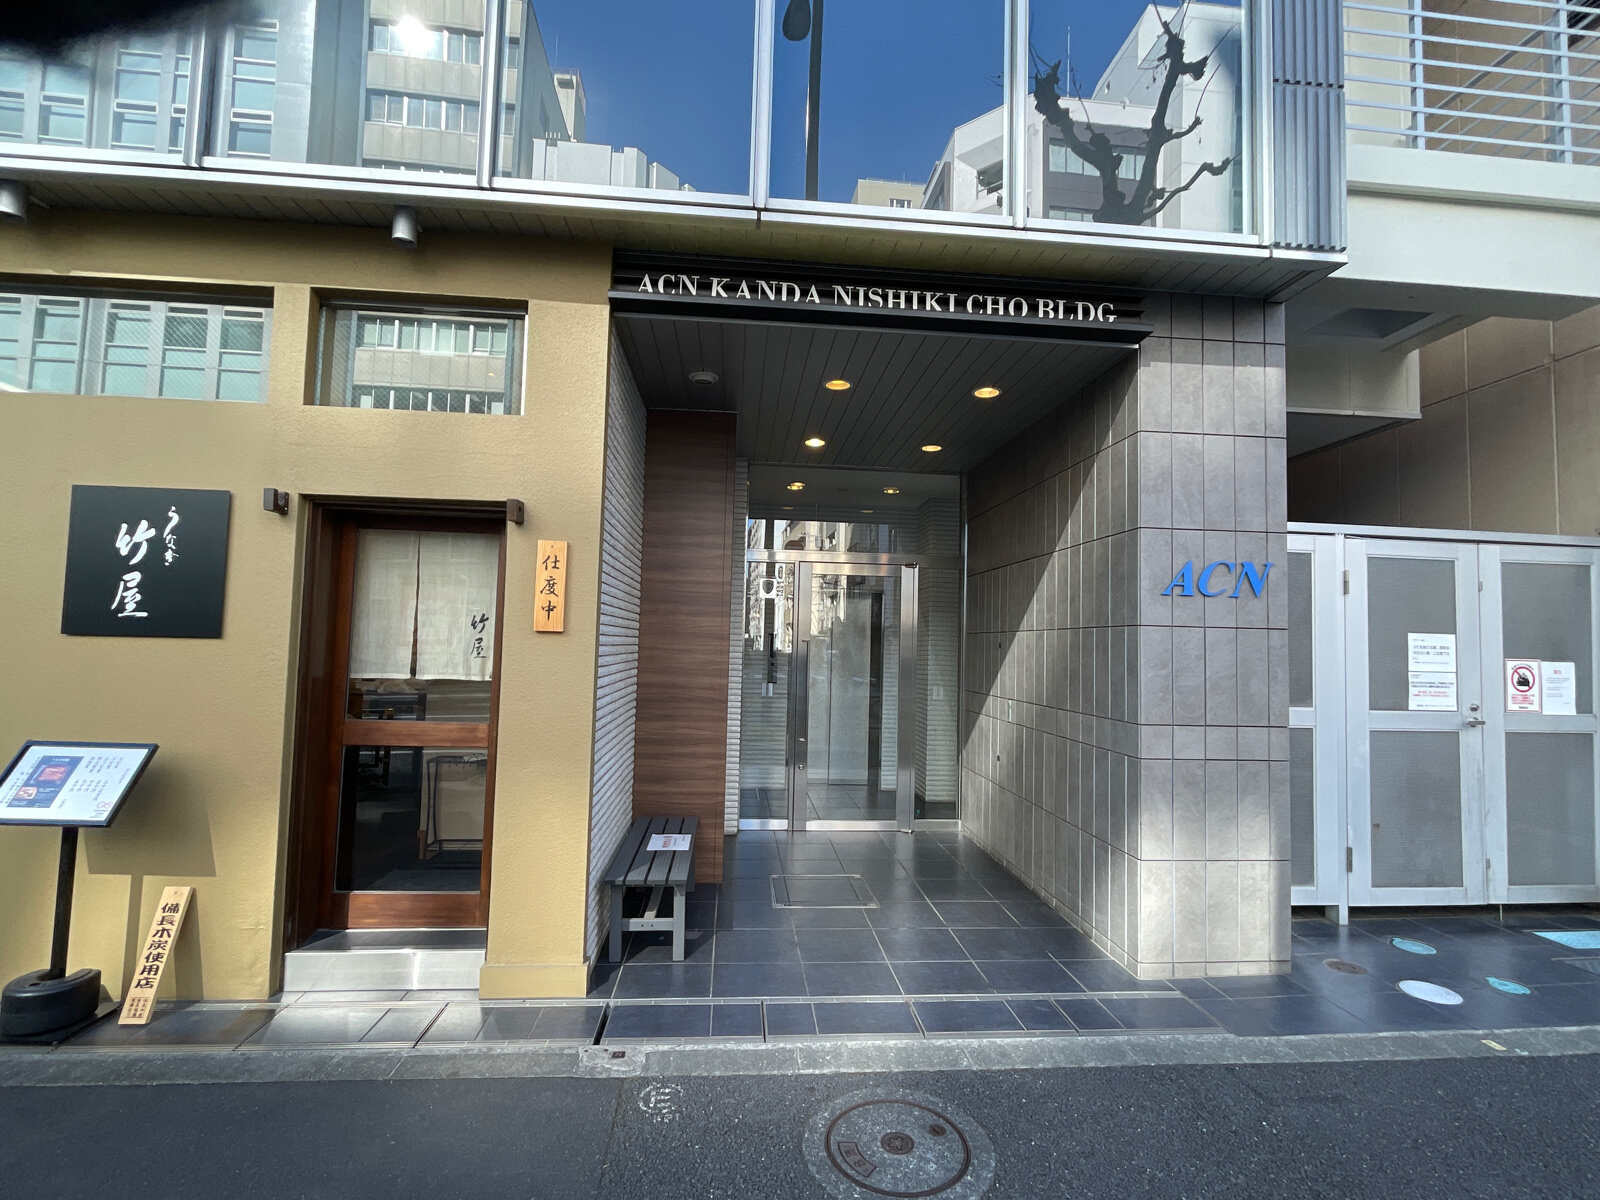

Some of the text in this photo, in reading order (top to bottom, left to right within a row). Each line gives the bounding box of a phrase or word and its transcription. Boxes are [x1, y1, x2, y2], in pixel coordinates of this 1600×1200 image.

[638, 273, 1117, 323] ACN KANDA NISHIKI CHO BLDG
[111, 519, 156, 617] 竹屋
[540, 555, 560, 621] 仕度中
[1160, 560, 1275, 598] ACN
[471, 613, 489, 659] 竹屋
[135, 902, 181, 989] 備長木炭使用店
